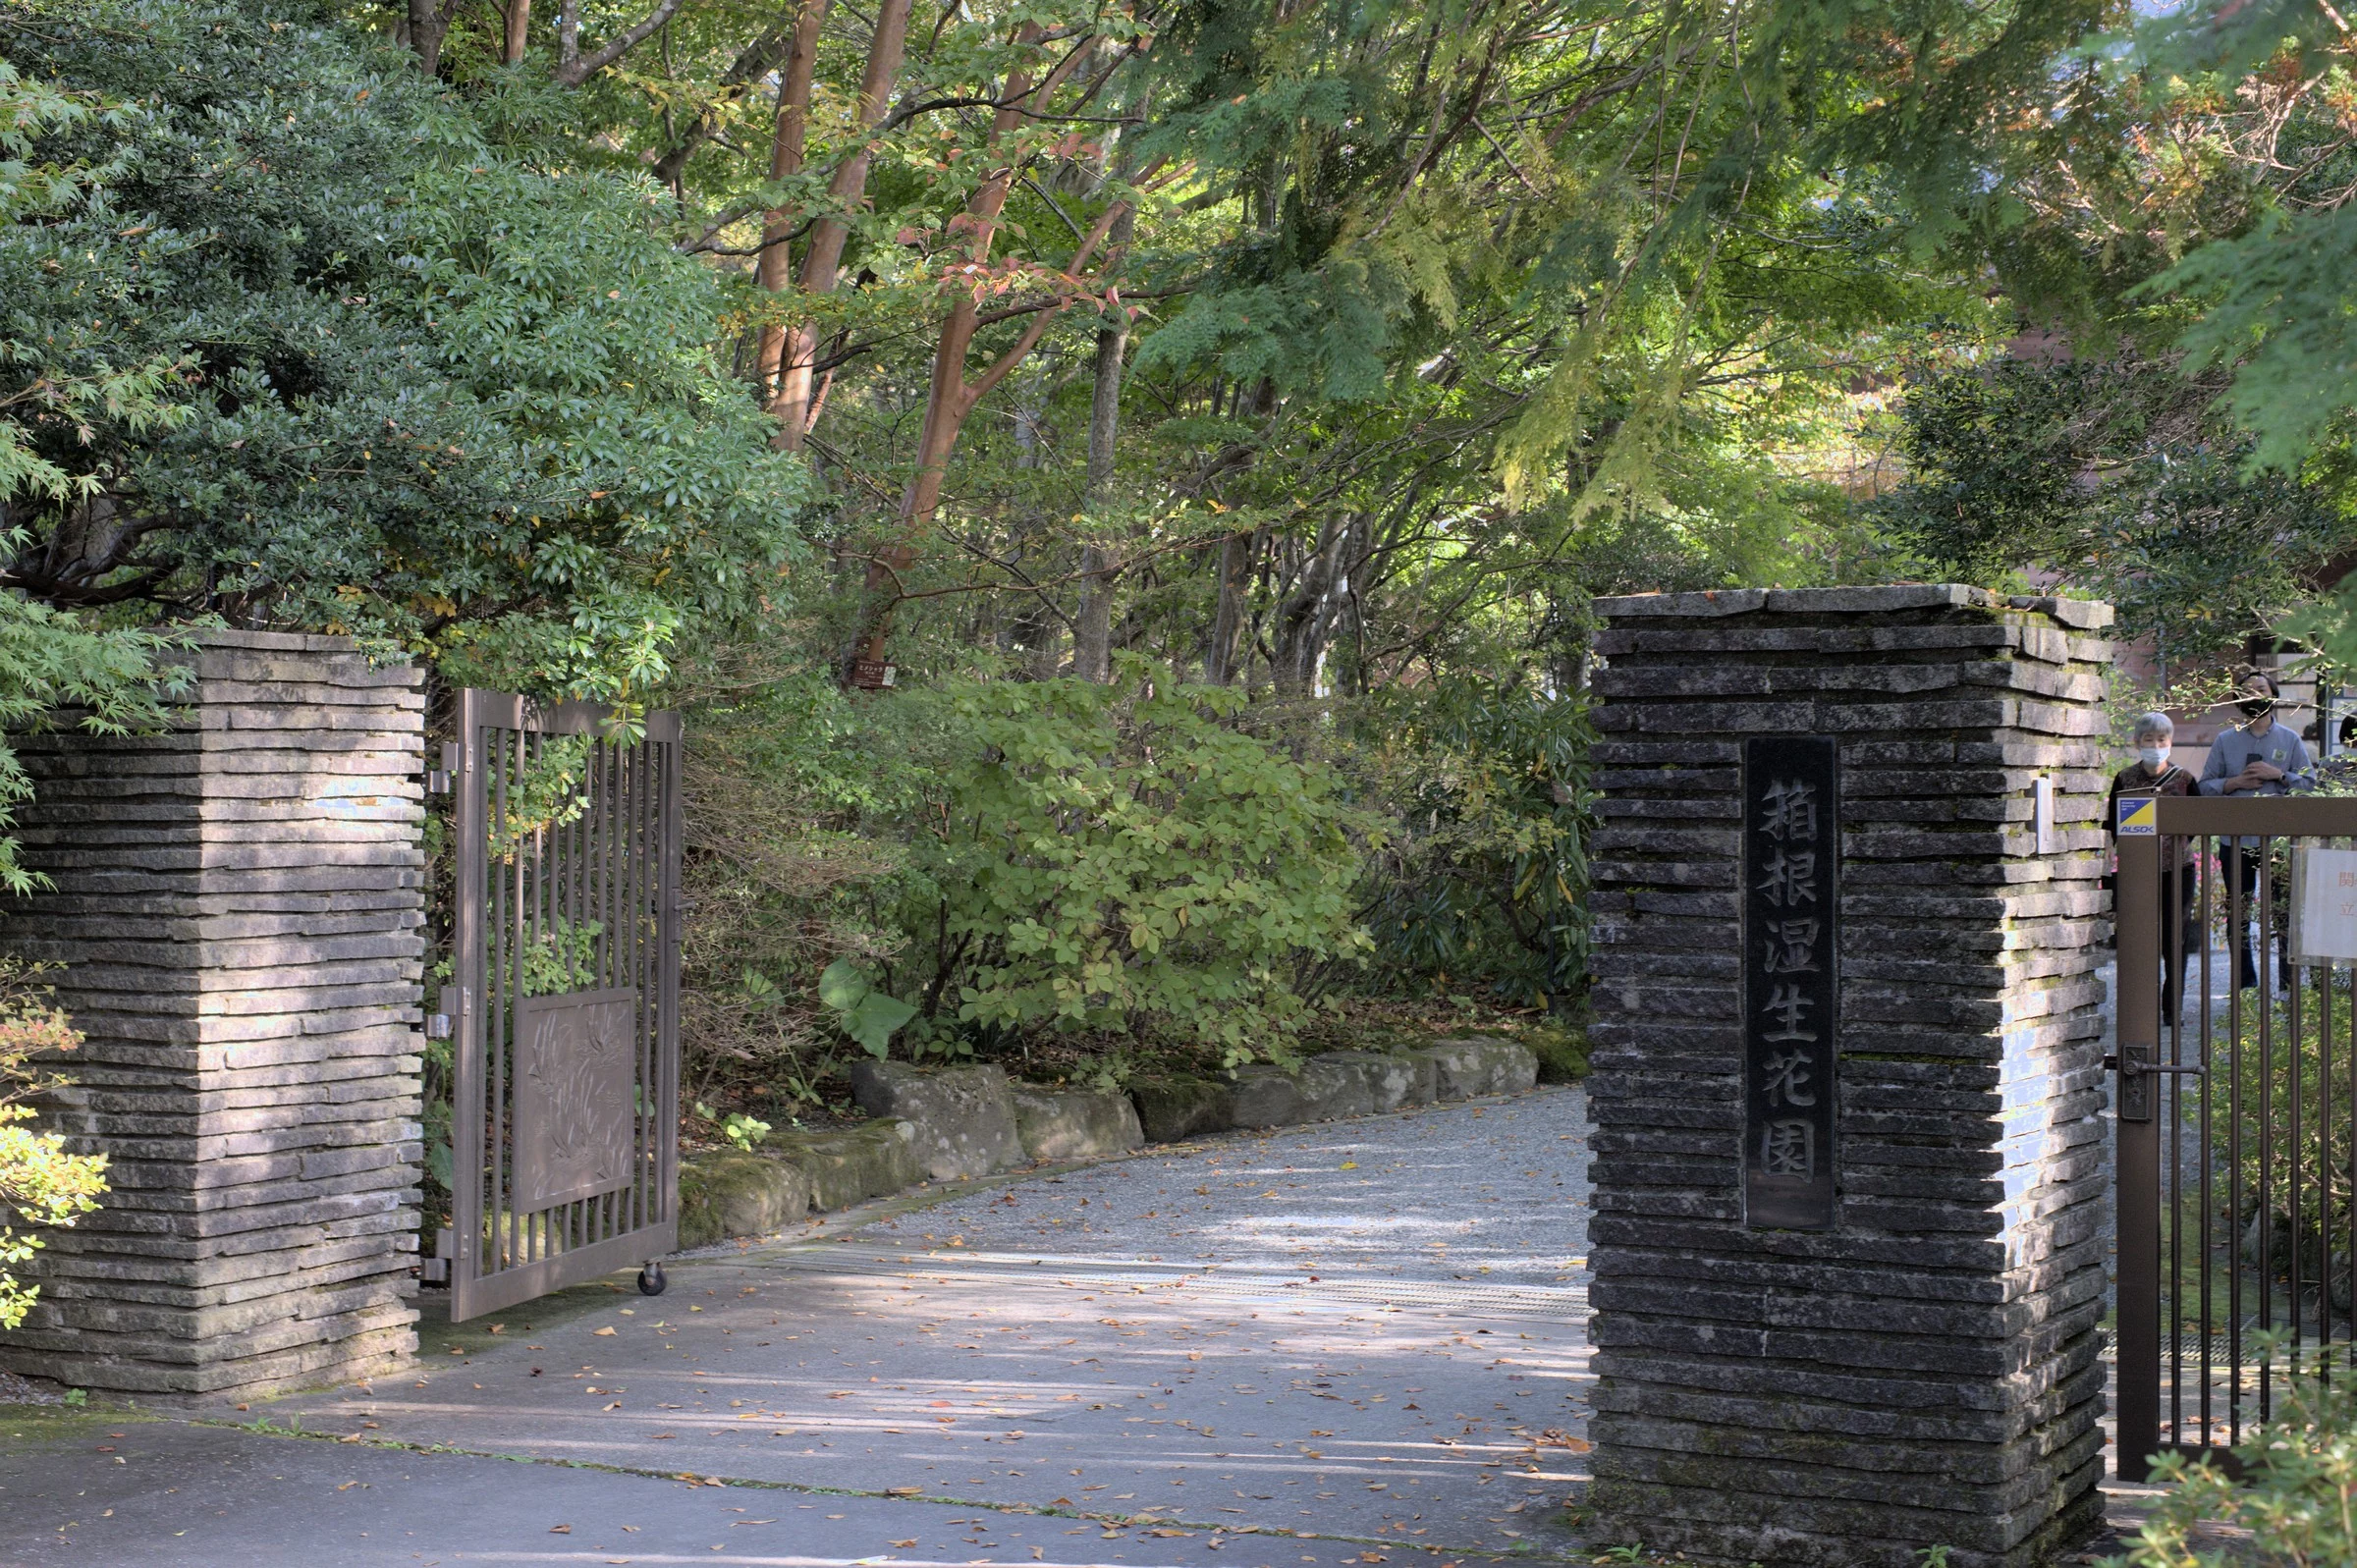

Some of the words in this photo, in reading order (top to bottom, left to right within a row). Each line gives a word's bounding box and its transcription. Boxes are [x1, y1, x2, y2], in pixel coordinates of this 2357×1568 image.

[1756, 779, 1821, 1184] 箱根湿生花園
[2338, 871, 2357, 888] 関
